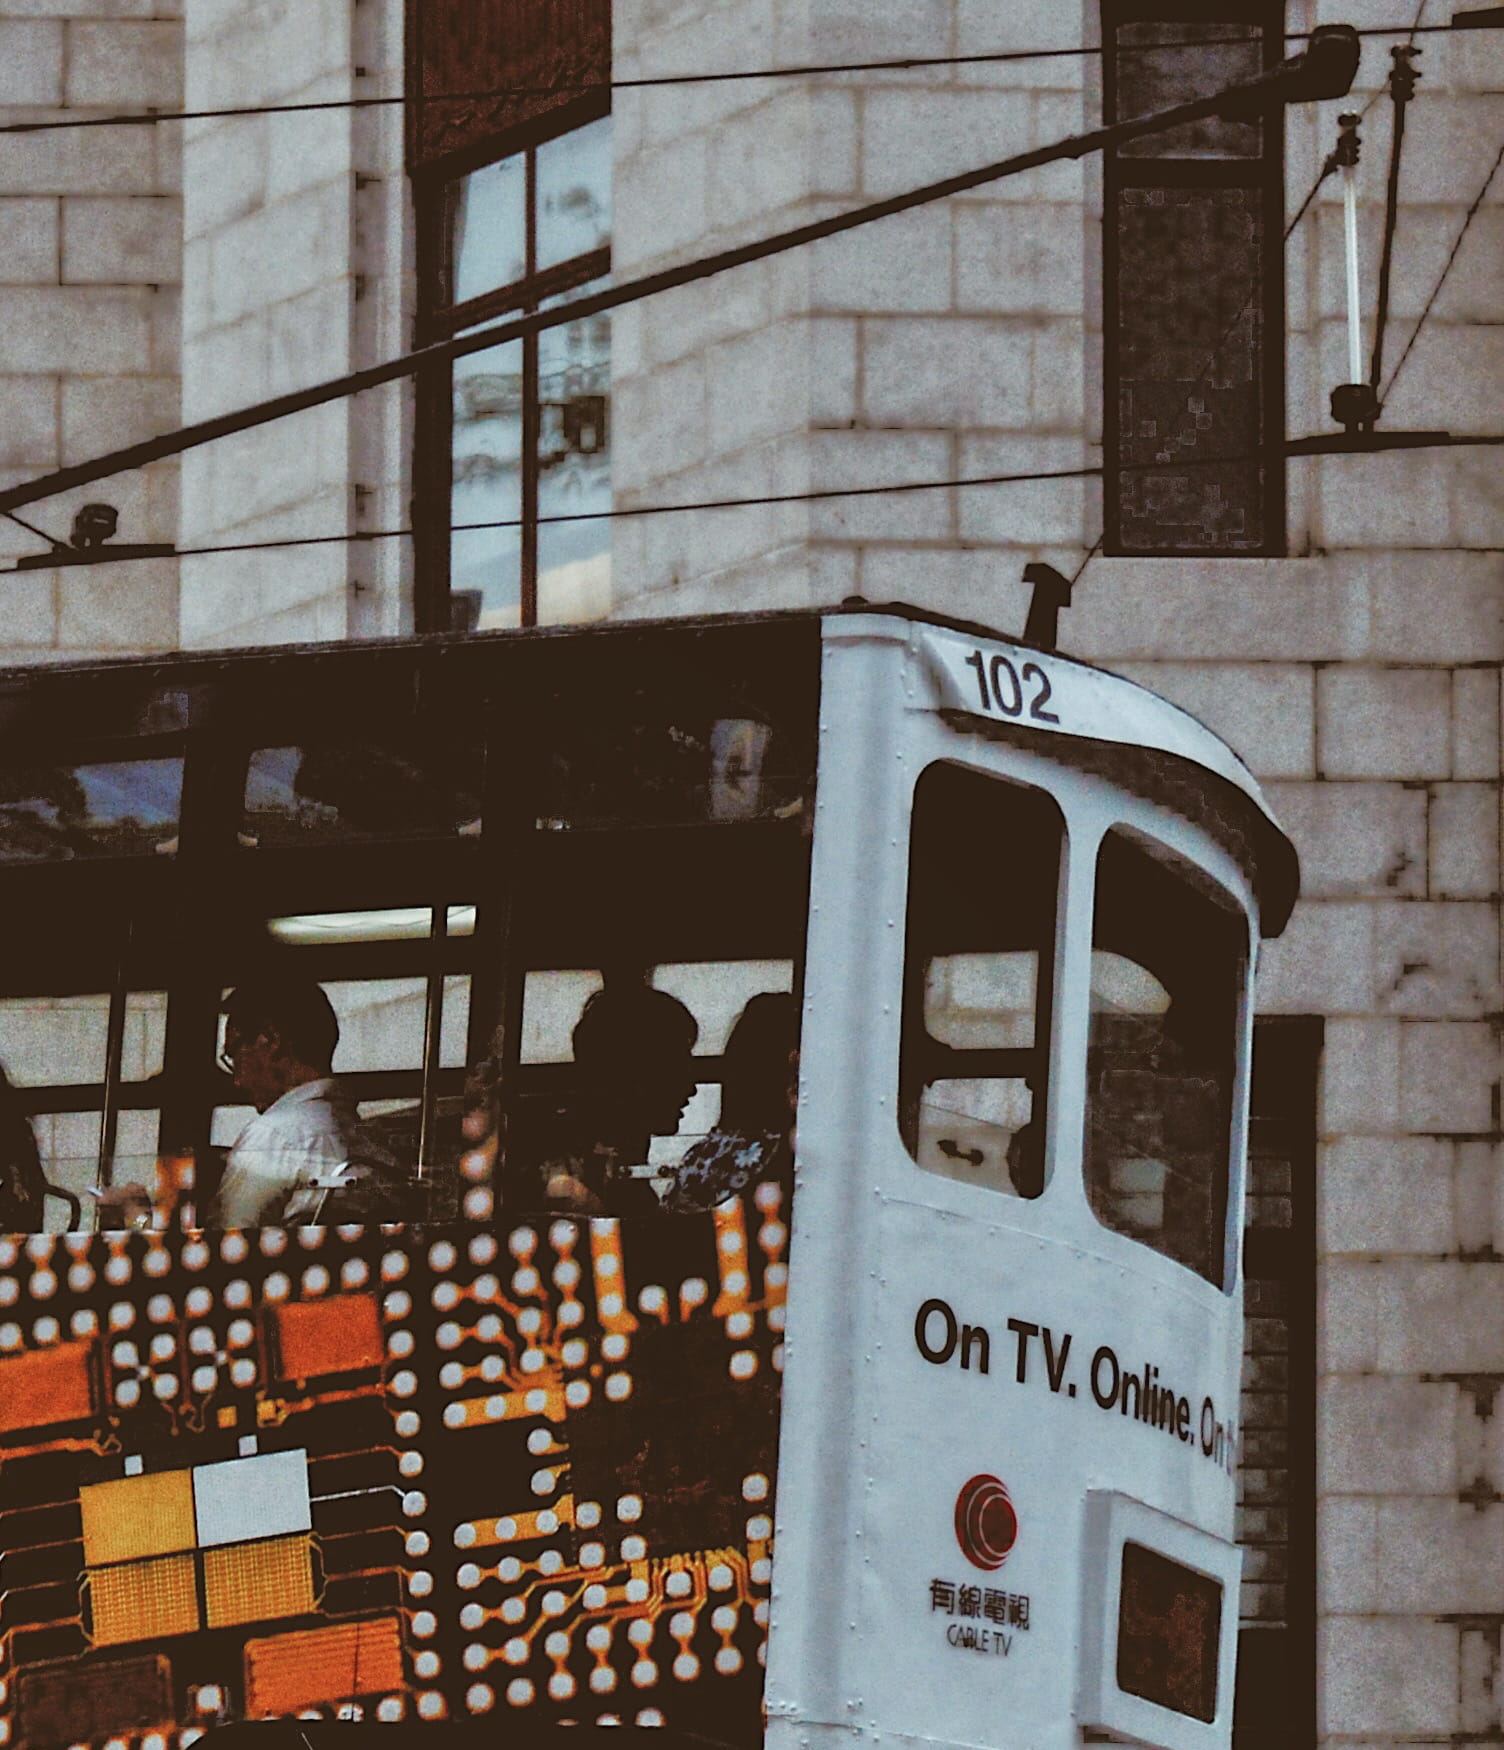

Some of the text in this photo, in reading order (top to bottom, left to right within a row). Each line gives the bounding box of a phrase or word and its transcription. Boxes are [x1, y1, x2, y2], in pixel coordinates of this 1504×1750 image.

[964, 650, 1060, 727] 102
[914, 1298, 990, 1375] On
[1007, 1317, 1077, 1398] TV.
[1091, 1345, 1195, 1446] Online.
[929, 1578, 1030, 1631] 有線電視
[947, 1624, 1013, 1656] CABLE TV
